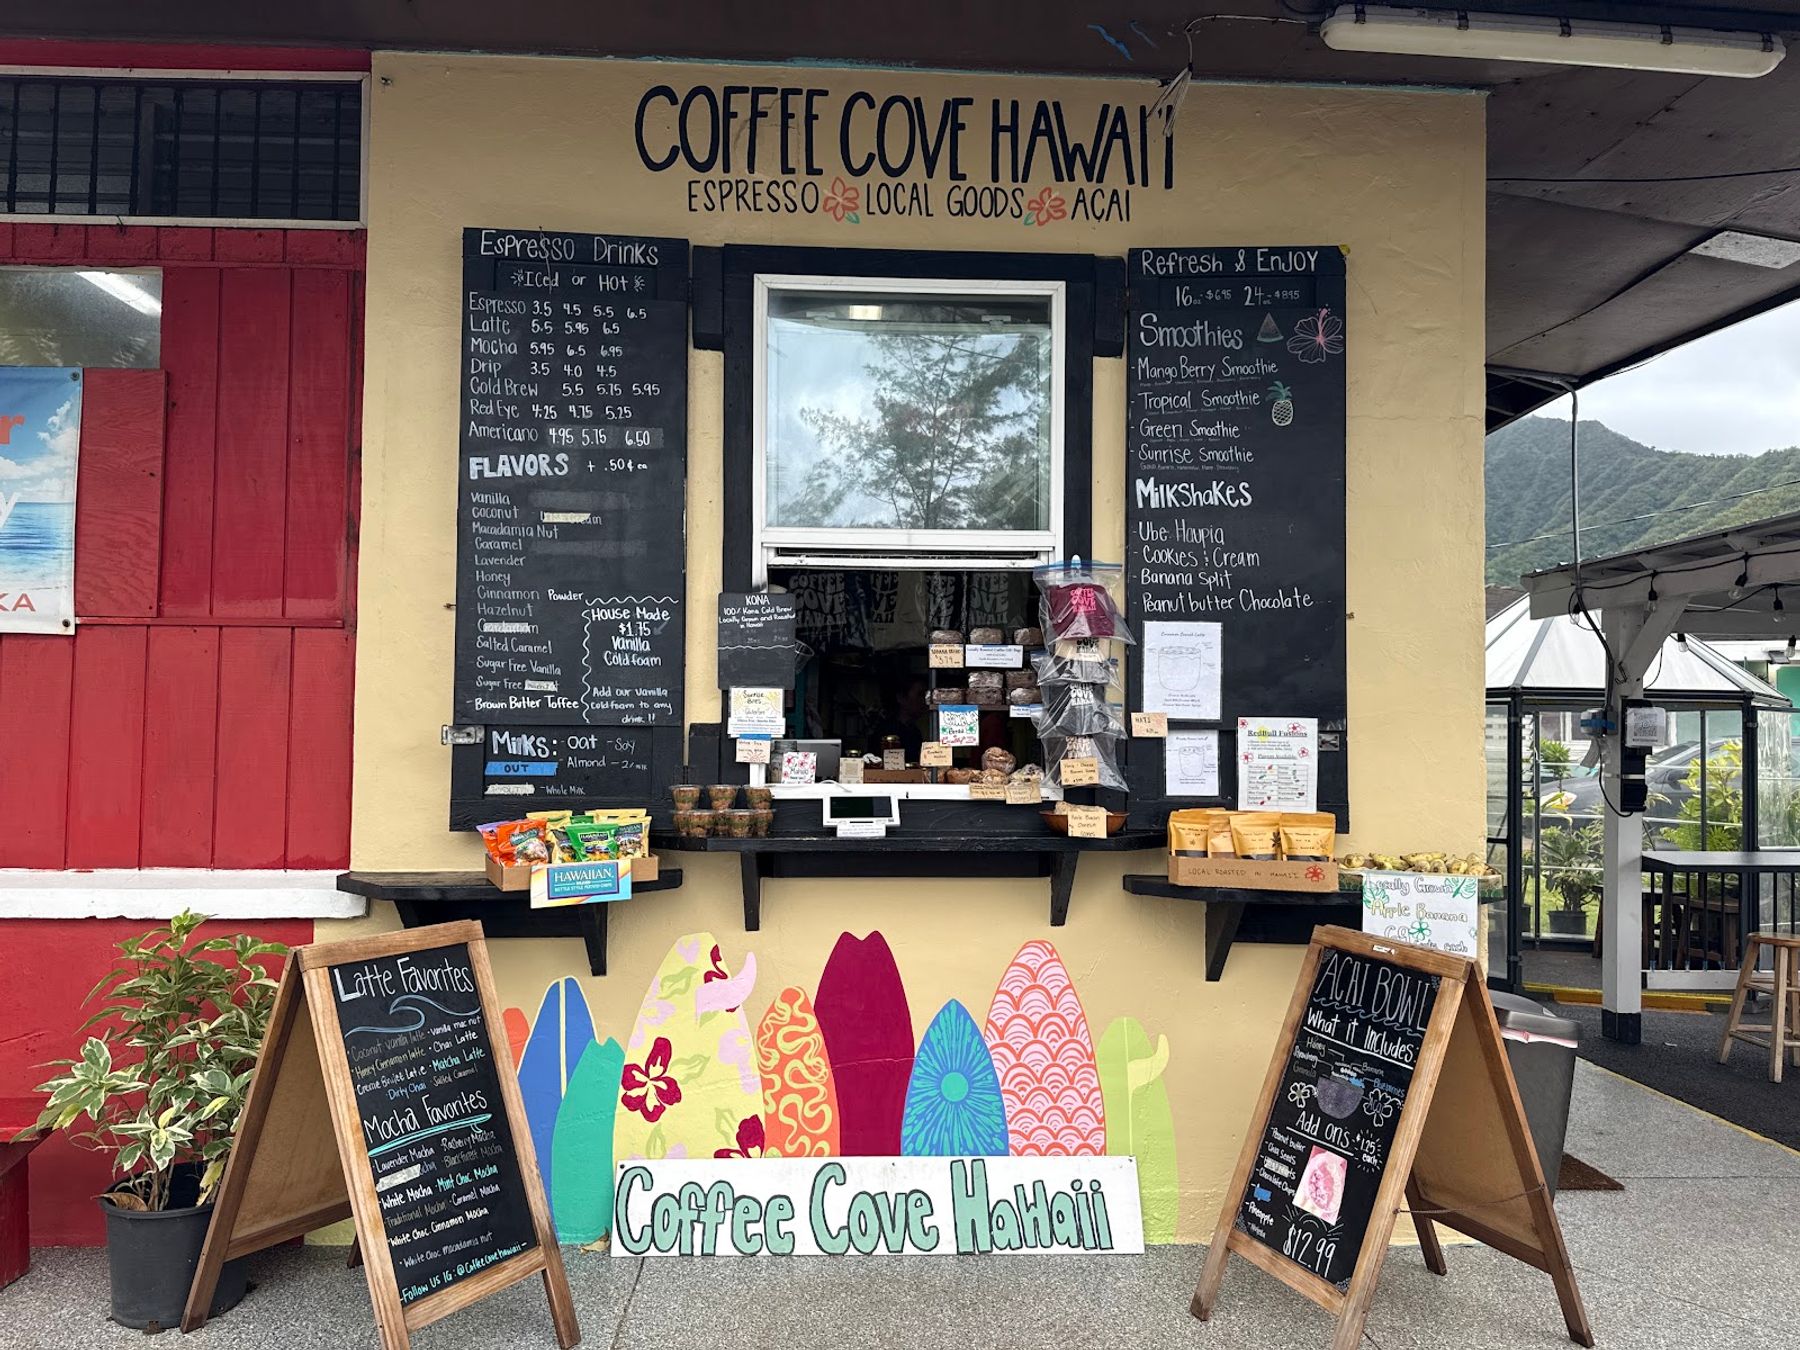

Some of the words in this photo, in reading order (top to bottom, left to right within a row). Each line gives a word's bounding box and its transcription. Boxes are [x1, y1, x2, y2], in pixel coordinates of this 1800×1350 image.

[634, 85, 829, 175] COFFEE
[839, 91, 973, 181] COVE
[688, 178, 819, 213] ESPRESSO
[866, 182, 934, 217] LOCAL
[947, 185, 1024, 218] GOODS
[480, 230, 575, 261] Espresso
[594, 236, 659, 266] Drinks
[1142, 250, 1223, 275] Refresh
[571, 275, 587, 286] or
[469, 291, 526, 315] Espresso
[532, 300, 552, 316] 3.5
[563, 303, 581, 316] 4.5
[593, 306, 614, 318] 5.5
[627, 307, 647, 320] 6.5
[470, 315, 510, 334] Latte
[531, 318, 553, 334] 5.5
[565, 322, 589, 335] 5.95
[602, 322, 620, 335] 6.5
[1139, 312, 1244, 350] Smoothies
[471, 336, 518, 355] Mocha
[530, 342, 555, 355] 5.95
[566, 344, 586, 356] 6.5
[600, 346, 623, 357] 6.95
[471, 358, 502, 377] Drip
[530, 362, 550, 376] 3.5
[1222, 355, 1279, 377] Smoothie
[470, 377, 500, 395] Cold
[505, 379, 538, 396] Brew
[562, 383, 584, 396] 5.5
[632, 383, 661, 396] 5.95
[471, 399, 493, 415] Red
[497, 400, 520, 417] Eye
[605, 406, 632, 420] 5.25
[1138, 391, 1191, 414] Tropical
[1202, 389, 1260, 408] Smoothie
[469, 421, 538, 442] Americano
[625, 431, 651, 446] 6.50
[1139, 418, 1182, 437] Green
[1189, 419, 1240, 439] Smoothie
[1139, 443, 1193, 464] Sunrise
[1199, 446, 1254, 463] Smoothie
[469, 452, 569, 479] FLAVORS
[471, 492, 510, 505] Vanilla
[472, 506, 519, 518] Coconut
[472, 522, 534, 537] Macadamia
[537, 525, 558, 539] Nut
[1138, 521, 1169, 542] Ube
[1175, 519, 1224, 548] Haupia
[475, 537, 522, 550] Caramel
[475, 555, 526, 566] Lavender
[1143, 545, 1198, 567] Cookies
[1213, 547, 1260, 568] Cream
[476, 570, 511, 587] Honey
[1141, 568, 1193, 585] Banana
[1199, 570, 1232, 591] Split
[477, 585, 540, 600] Cinnamon
[548, 590, 584, 601] Powder
[745, 595, 770, 605] KONA
[1143, 592, 1185, 613] Peanut
[1239, 587, 1314, 612] Chocolate
[477, 602, 534, 616] Hazelnut
[636, 606, 671, 620] Made
[619, 621, 651, 637] $1.75
[476, 635, 509, 652] Salted
[511, 637, 553, 654] Caramel
[611, 636, 651, 652] Vanilla
[476, 656, 507, 673] Sugar
[509, 659, 527, 672] Free
[529, 660, 561, 676] Vanilla
[476, 675, 501, 691] Sugar
[504, 678, 522, 689] Free
[593, 686, 611, 697] Add
[616, 689, 631, 697] our
[475, 698, 507, 710] Brown
[509, 696, 541, 709] Butter
[544, 695, 579, 708] Toffee
[654, 703, 672, 715] any
[615, 738, 636, 755] Soy
[504, 764, 529, 773] OUT
[567, 756, 606, 768] Almond
[1371, 899, 1410, 919] Apple
[1416, 903, 1468, 922] Banana
[333, 964, 395, 1002] Latte
[397, 957, 474, 993] Favorites
[1315, 953, 1370, 1007] ACAI
[1372, 967, 1430, 1031] BOWL
[1306, 1008, 1340, 1036] What
[1347, 1019, 1359, 1045] it
[462, 1046, 486, 1062] Latte
[1306, 1036, 1326, 1057] Honey
[364, 1107, 421, 1143] Mocha
[422, 1090, 487, 1125] Favorites
[1296, 1111, 1319, 1136] Add
[374, 1154, 409, 1173] Lavender
[616, 1164, 795, 1255] Coffee
[809, 1162, 940, 1255] Cove
[1283, 1223, 1336, 1278] $12.99
